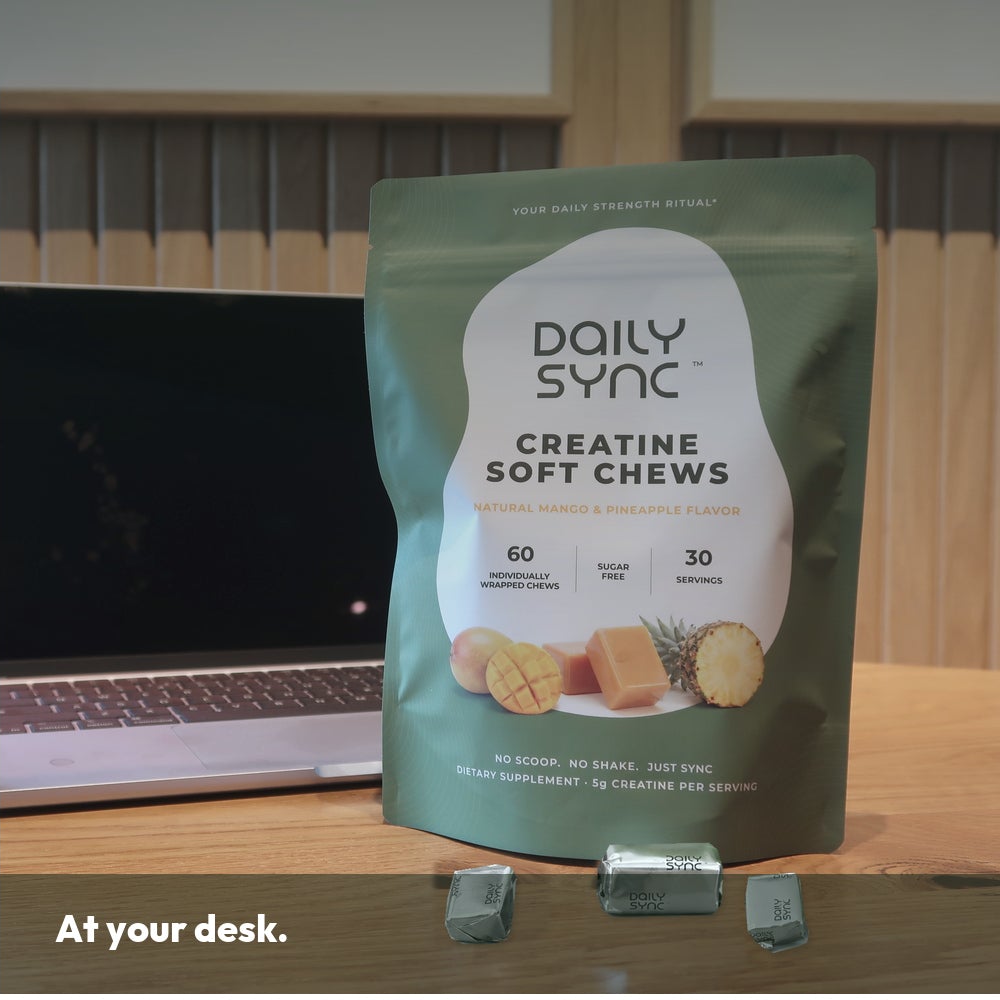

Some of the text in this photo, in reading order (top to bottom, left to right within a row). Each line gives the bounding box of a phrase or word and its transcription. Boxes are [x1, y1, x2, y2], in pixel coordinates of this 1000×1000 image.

[513, 206, 546, 216] YOUR
[551, 203, 588, 214] DAILY
[593, 200, 660, 212] STRENGTH
[534, 318, 686, 357] DAILY
[537, 362, 680, 399] SYNC
[516, 433, 698, 456] CREATINE
[486, 461, 729, 485] SOFT CHEWS
[473, 503, 741, 517] NATURAL MANGO & PINEAPPLE FLAVOR
[507, 546, 535, 563] 60
[685, 550, 713, 567] 30
[597, 562, 630, 571] SUGAR
[489, 571, 550, 581] INDIVIDUALLY
[601, 572, 625, 581] FREE
[676, 576, 723, 585] SERVINGS
[480, 581, 560, 590] WRAPPED CHEWS
[495, 754, 713, 774] NO SCOOP. NO SHAKE. JUST SYNC
[456, 765, 758, 792] DIETARY SUPPLEMENT 5g CREATINE PER SERVING
[666, 862, 702, 871] SYNC
